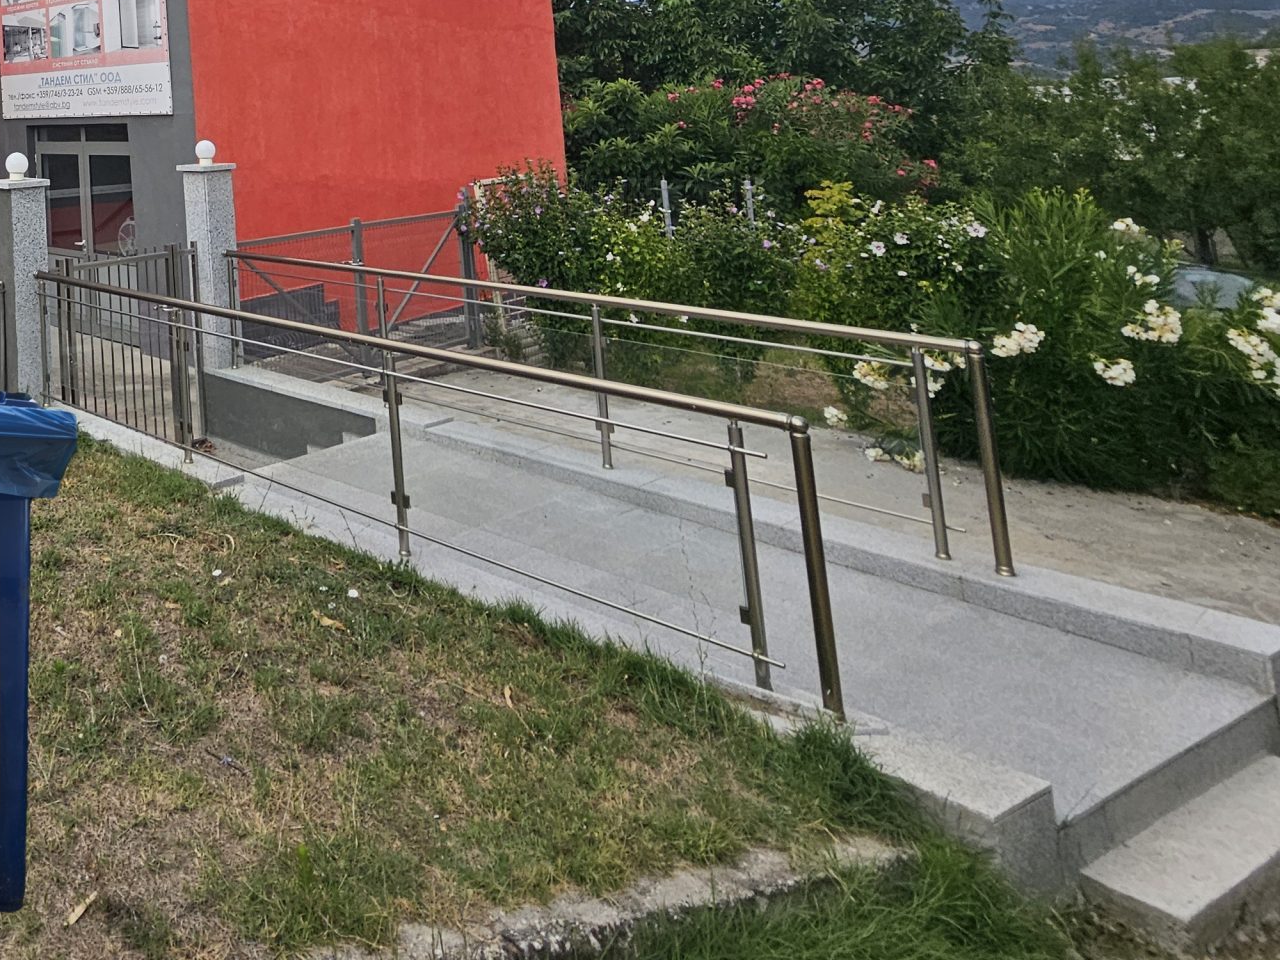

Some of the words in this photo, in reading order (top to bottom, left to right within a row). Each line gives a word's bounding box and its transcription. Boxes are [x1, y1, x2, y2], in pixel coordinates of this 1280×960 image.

[100, 71, 122, 83] ООД
[87, 88, 102, 96] GSM
[103, 83, 163, 96] +359/888/65-56-12
